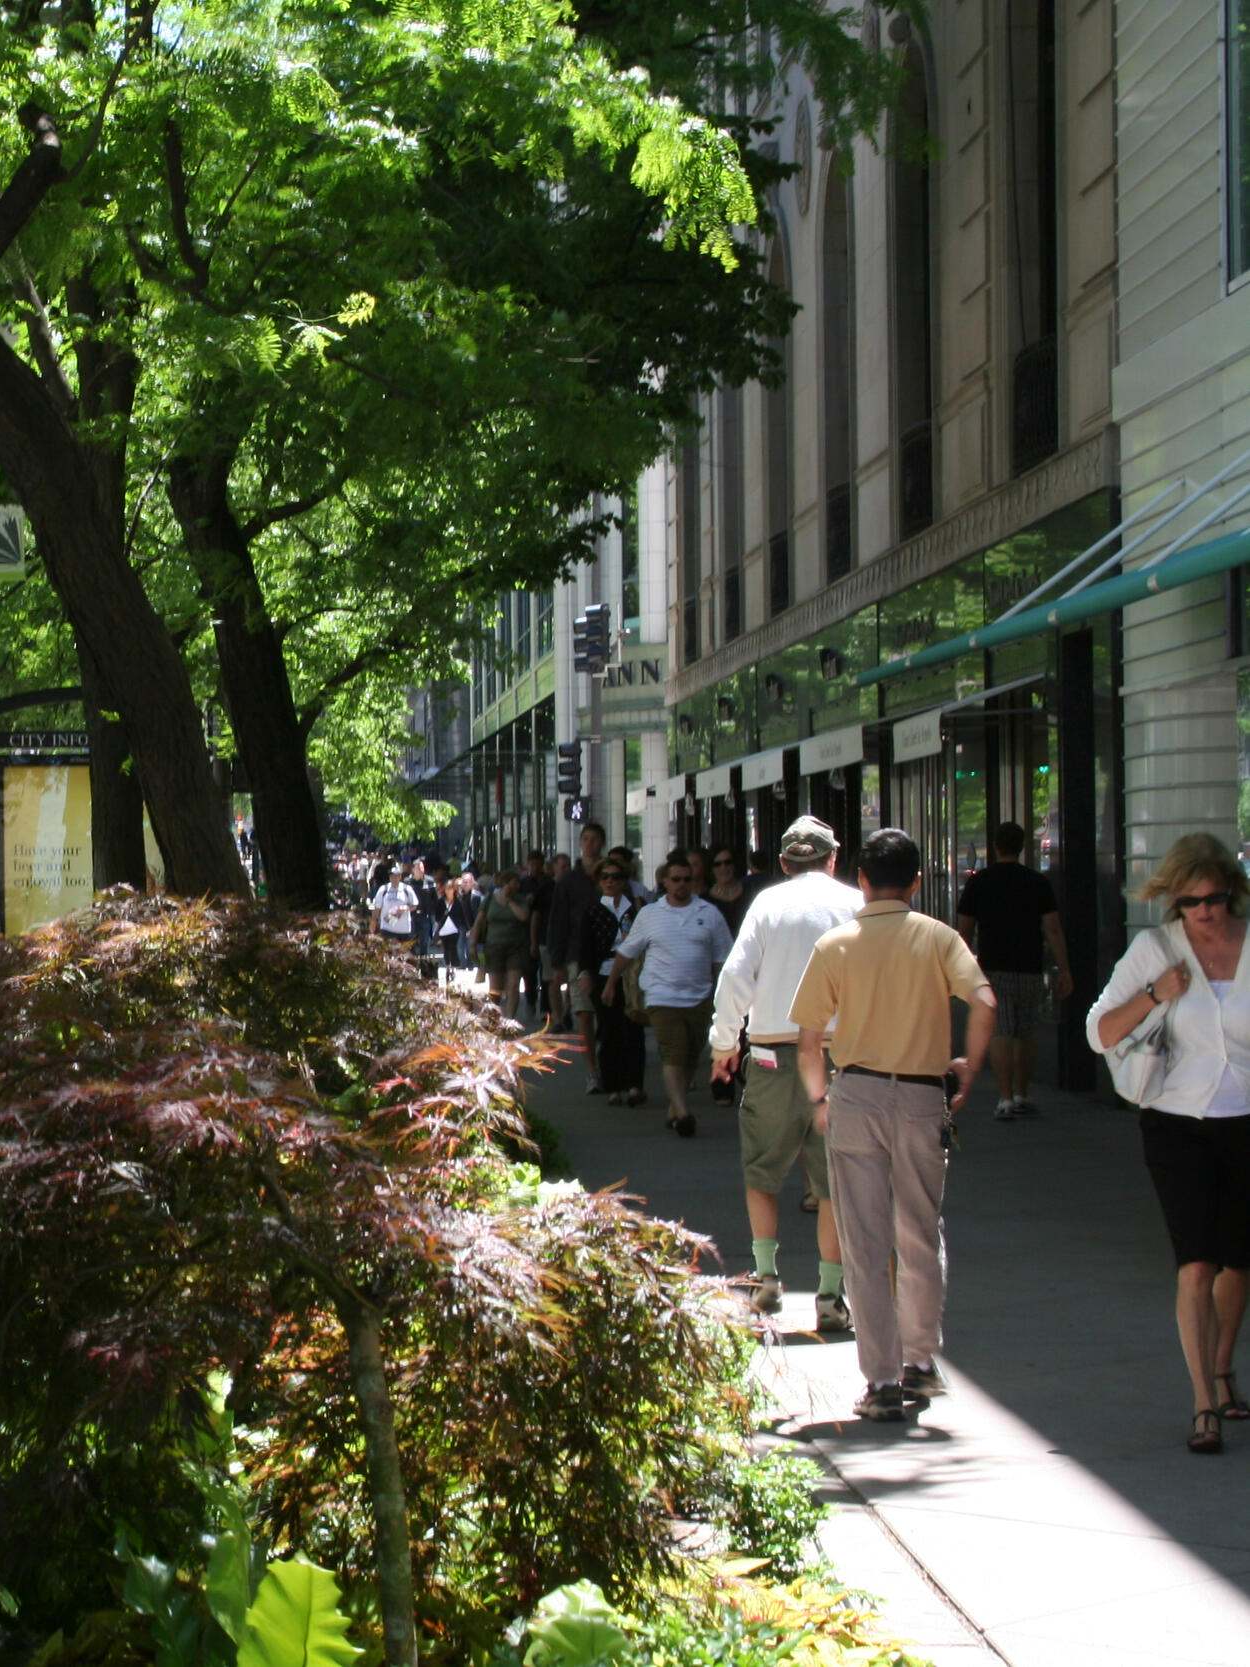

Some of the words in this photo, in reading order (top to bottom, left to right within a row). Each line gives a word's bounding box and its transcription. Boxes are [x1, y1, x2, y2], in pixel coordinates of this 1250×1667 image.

[10, 734, 46, 747] CITY
[52, 733, 89, 747] INFO
[14, 844, 47, 856] Have
[53, 847, 81, 860] your
[14, 859, 42, 872] beer
[46, 859, 71, 872] and
[14, 876, 48, 889] enjoy
